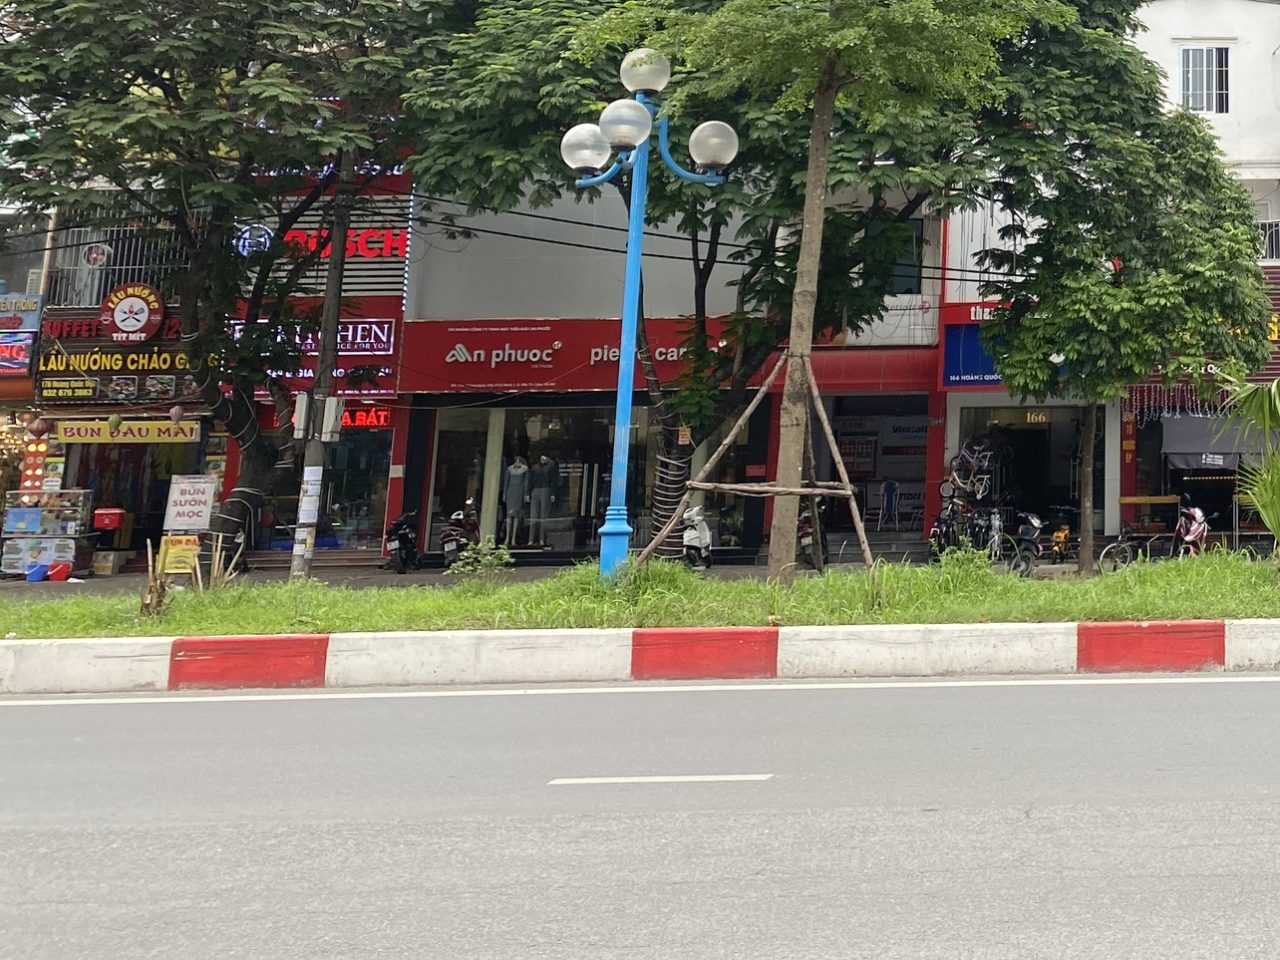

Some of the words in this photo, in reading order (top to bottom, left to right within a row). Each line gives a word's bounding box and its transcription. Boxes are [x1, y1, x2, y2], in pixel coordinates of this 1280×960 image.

[69, 346, 123, 372] NƯỚNG
[126, 346, 171, 371] CHẢO
[490, 343, 553, 368] phuoc
[1026, 412, 1046, 424] 166
